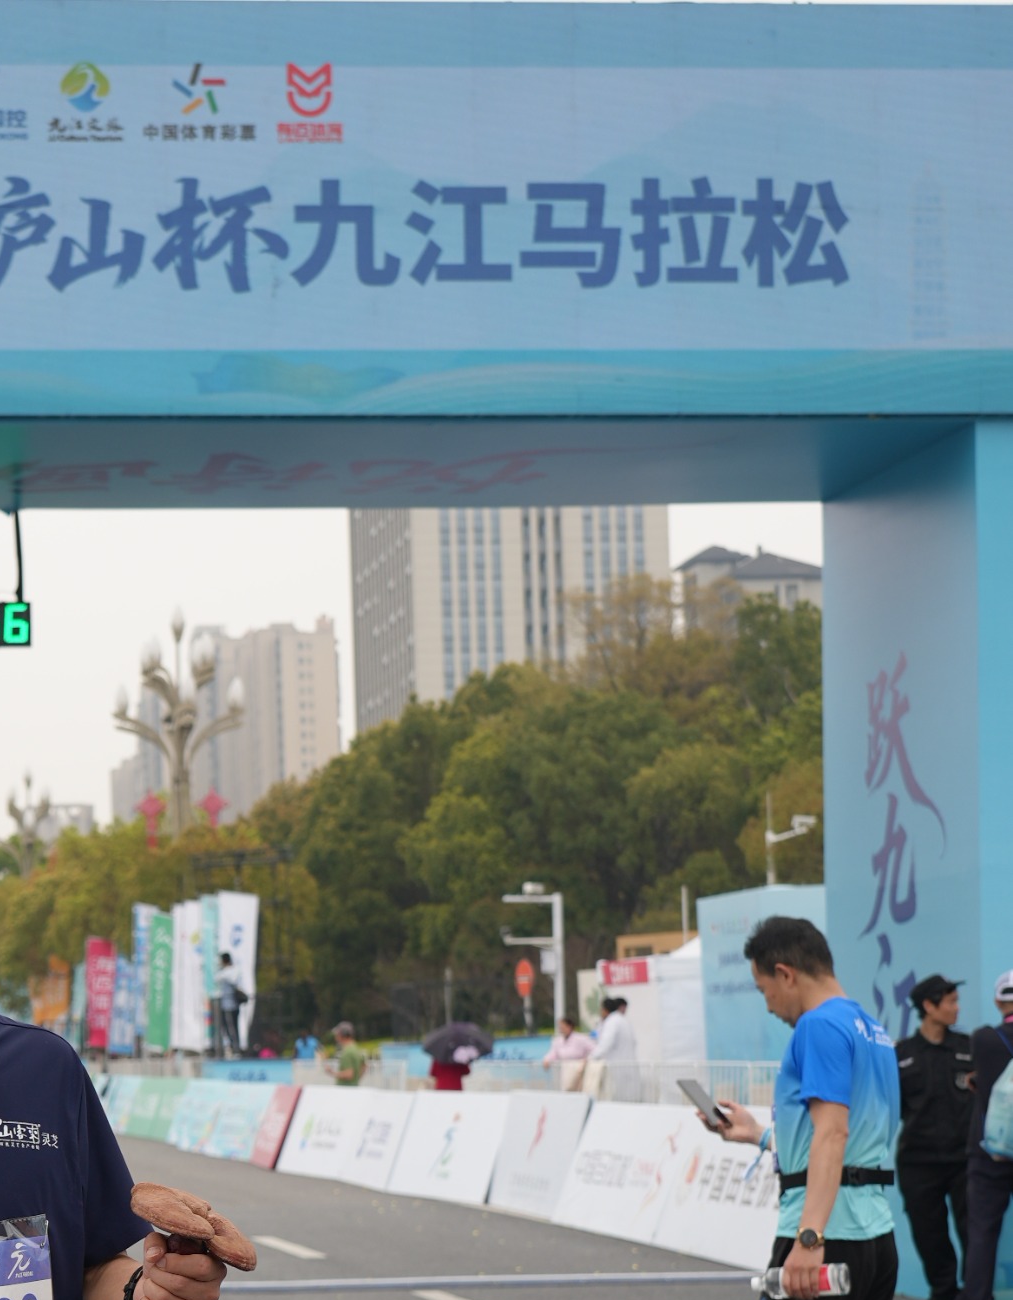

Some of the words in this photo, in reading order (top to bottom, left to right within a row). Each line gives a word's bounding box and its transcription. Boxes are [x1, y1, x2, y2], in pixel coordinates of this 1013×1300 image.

[143, 123, 257, 141] 中国体育彩票
[42, 1132, 59, 1149] 灵芝
